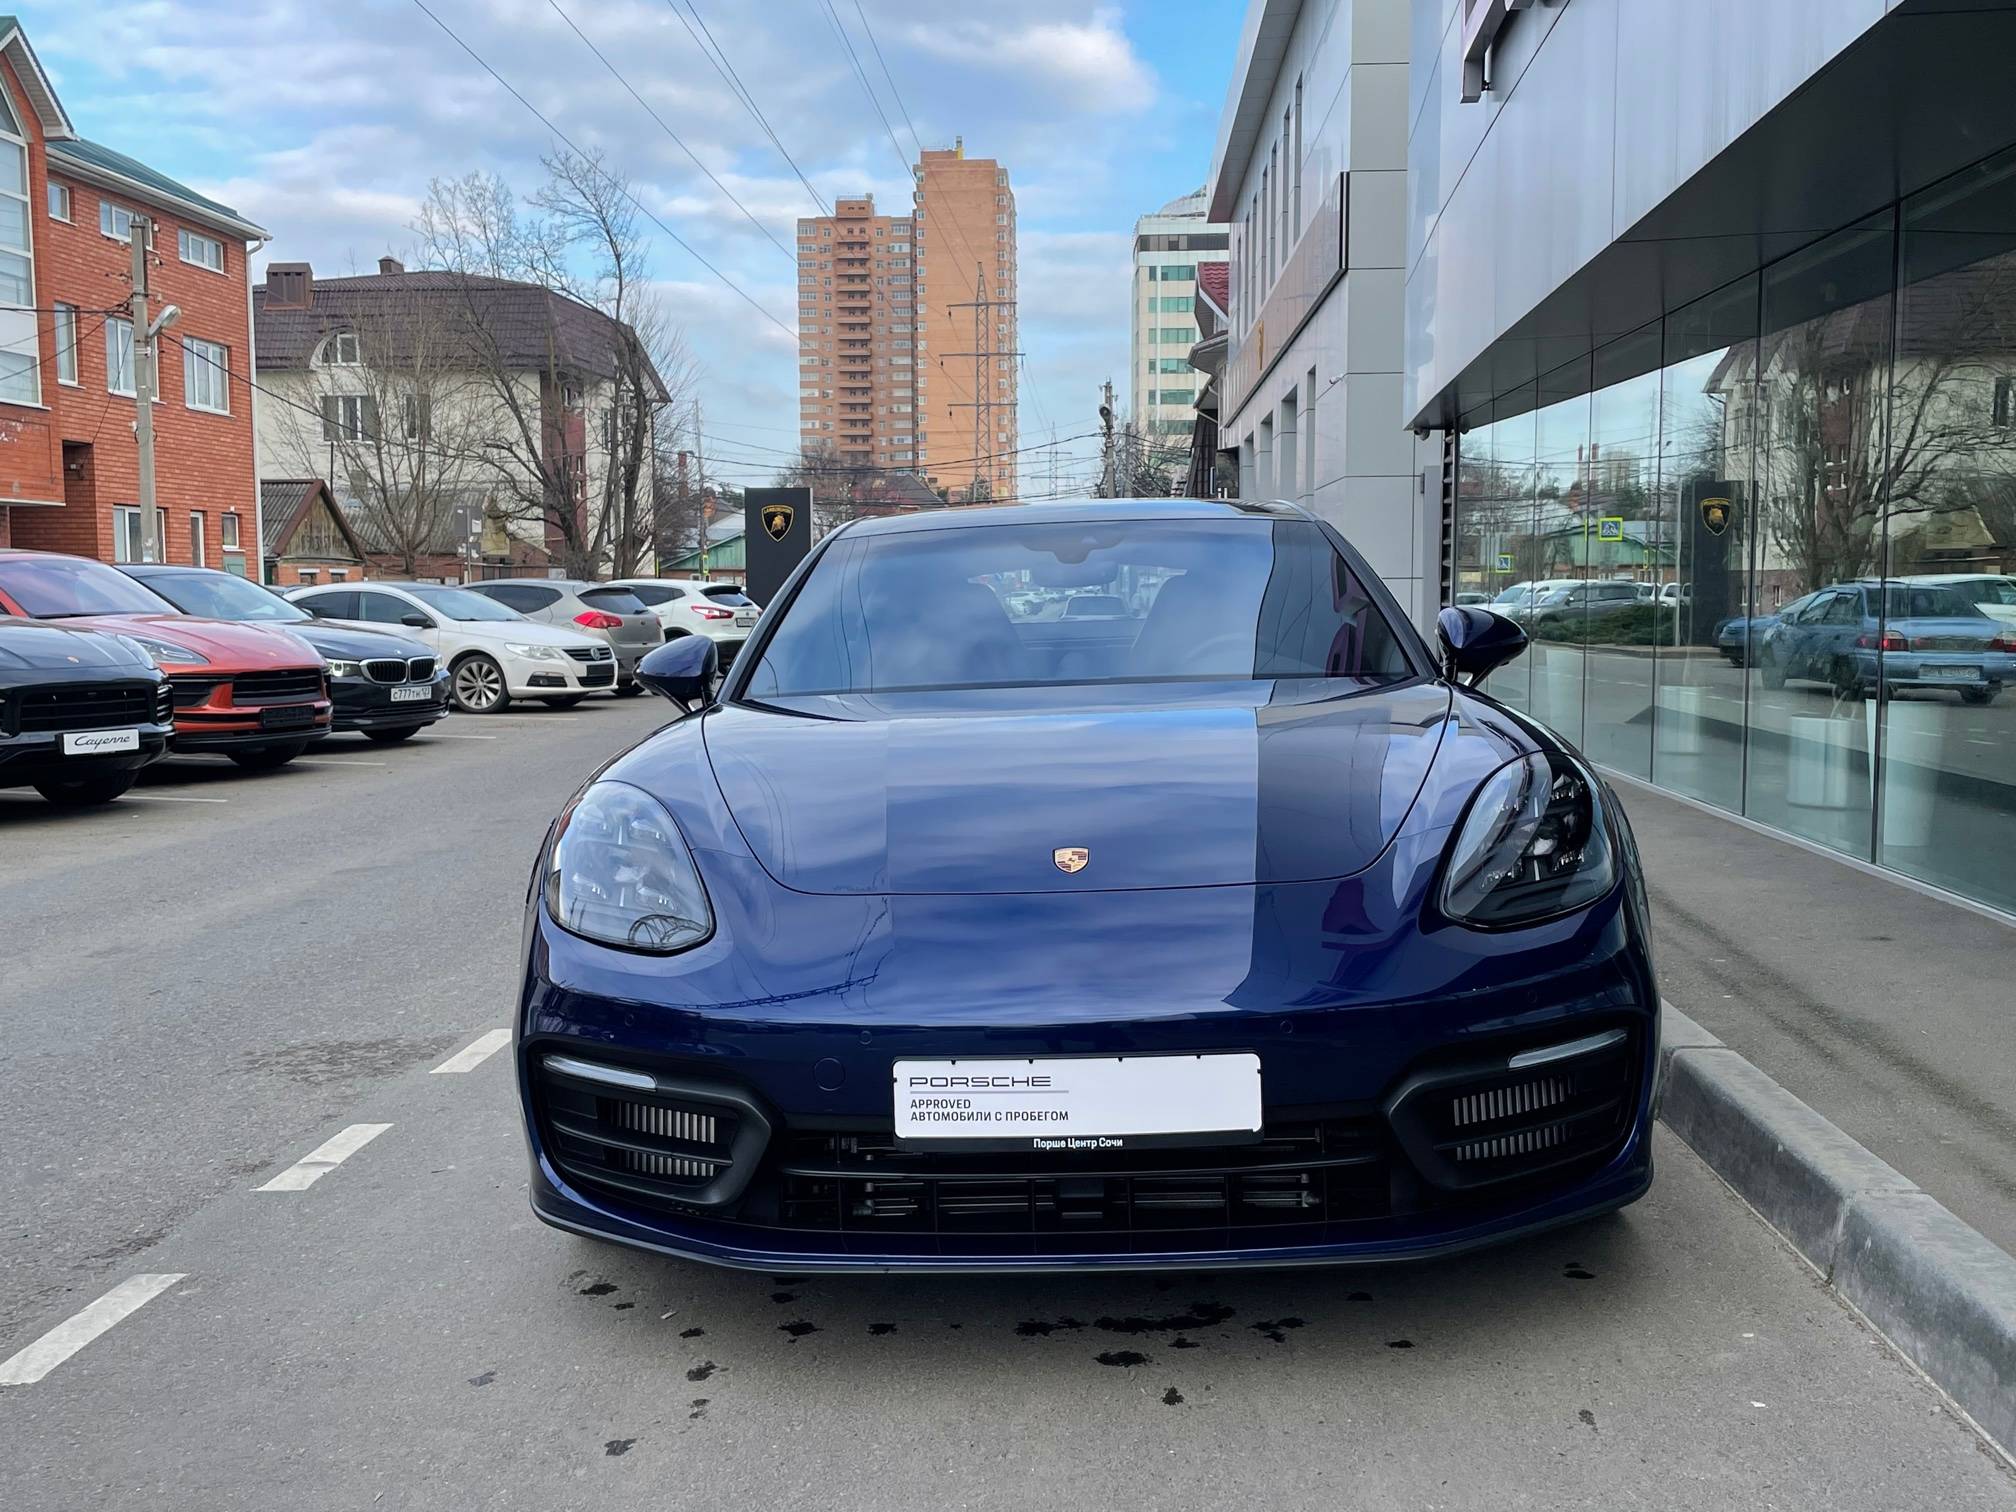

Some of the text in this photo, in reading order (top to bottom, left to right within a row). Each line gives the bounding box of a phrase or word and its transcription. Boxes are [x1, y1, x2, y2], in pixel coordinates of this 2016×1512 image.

[74, 735, 130, 751] Cayenne
[909, 1076, 1052, 1088] PORSCHE
[910, 1098, 971, 1110] APPROVED
[910, 1110, 1070, 1122] АВТОМОБИЛИ С ПРОБЕГОМ
[1033, 1136, 1123, 1151] Порше Центр Сочи
